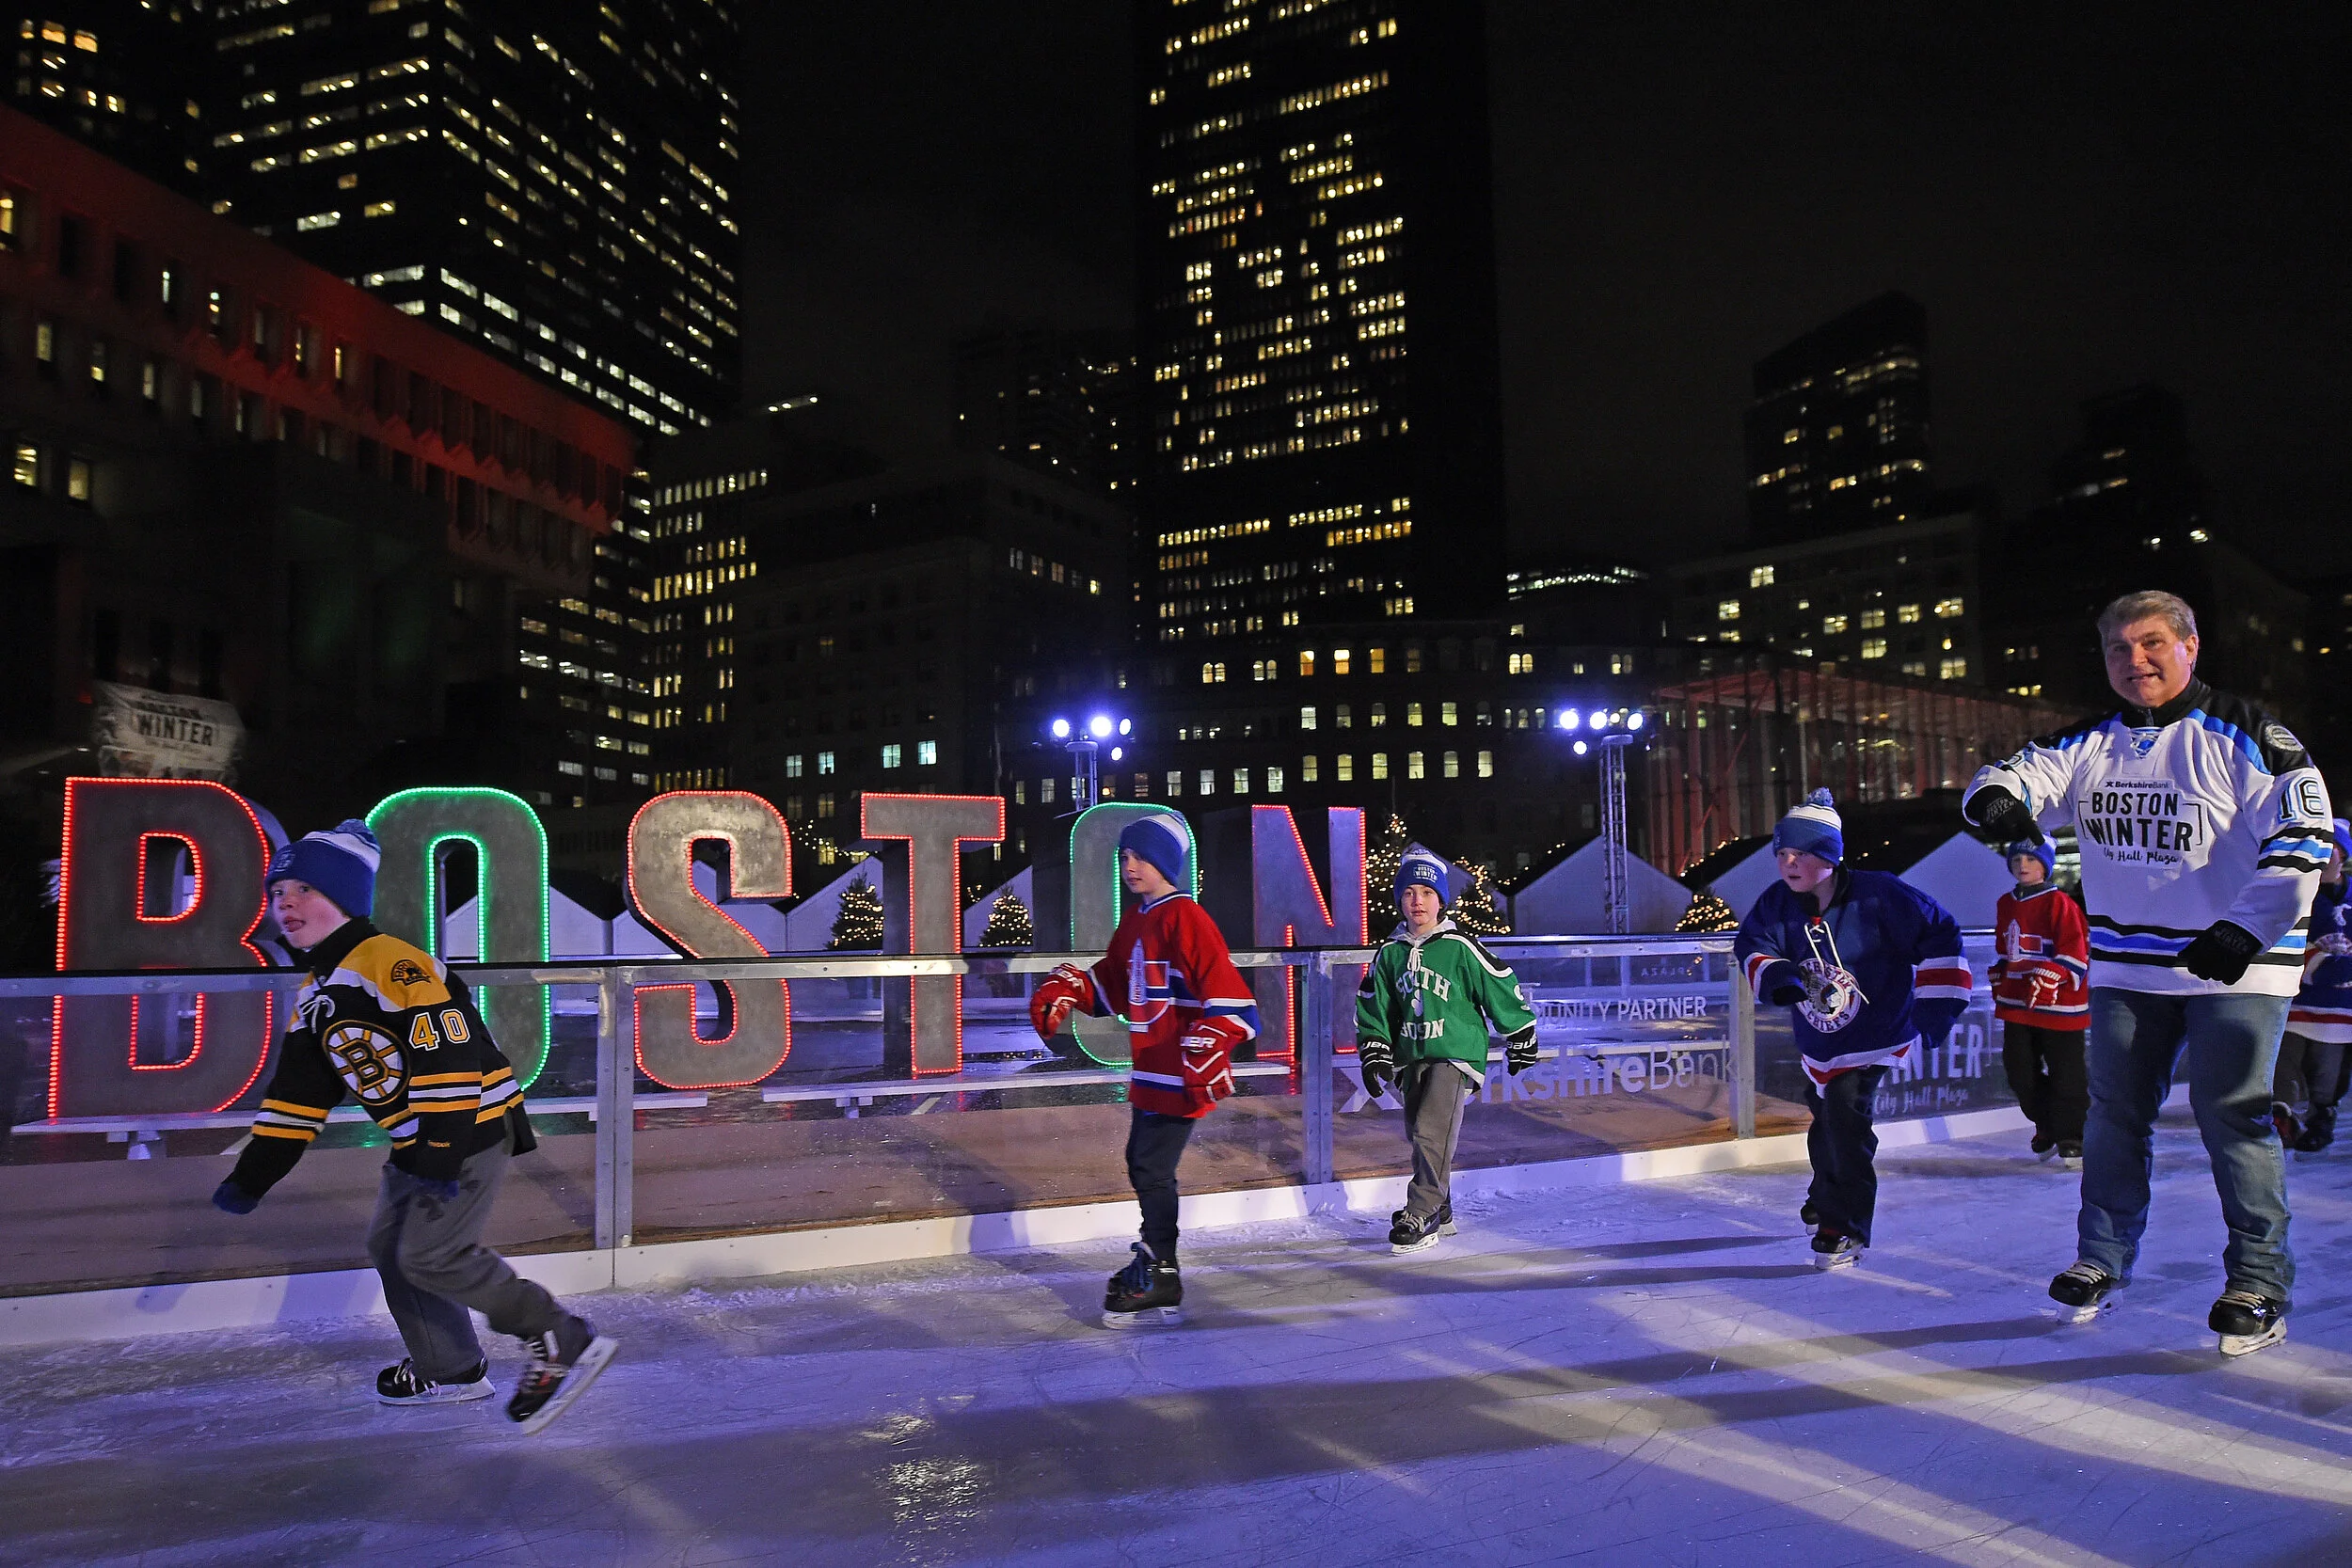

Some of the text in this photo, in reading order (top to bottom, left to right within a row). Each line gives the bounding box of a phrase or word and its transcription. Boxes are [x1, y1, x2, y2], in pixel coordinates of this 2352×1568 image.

[137, 713, 215, 746] WINTER
[2115, 781, 2169, 789] BerkshireBank
[2092, 792, 2179, 816] BOSTON
[2085, 817, 2194, 852] WINTER
[2117, 849, 2142, 863] Hall
[2146, 851, 2179, 865] Plaza
[48, 776, 1367, 1121] BOSTON
[1617, 995, 1707, 1022] PARTNER
[1806, 1011, 1851, 1032] CHIEFS
[408, 1008, 471, 1052] 40
[1902, 1085, 1931, 1114] Hall
